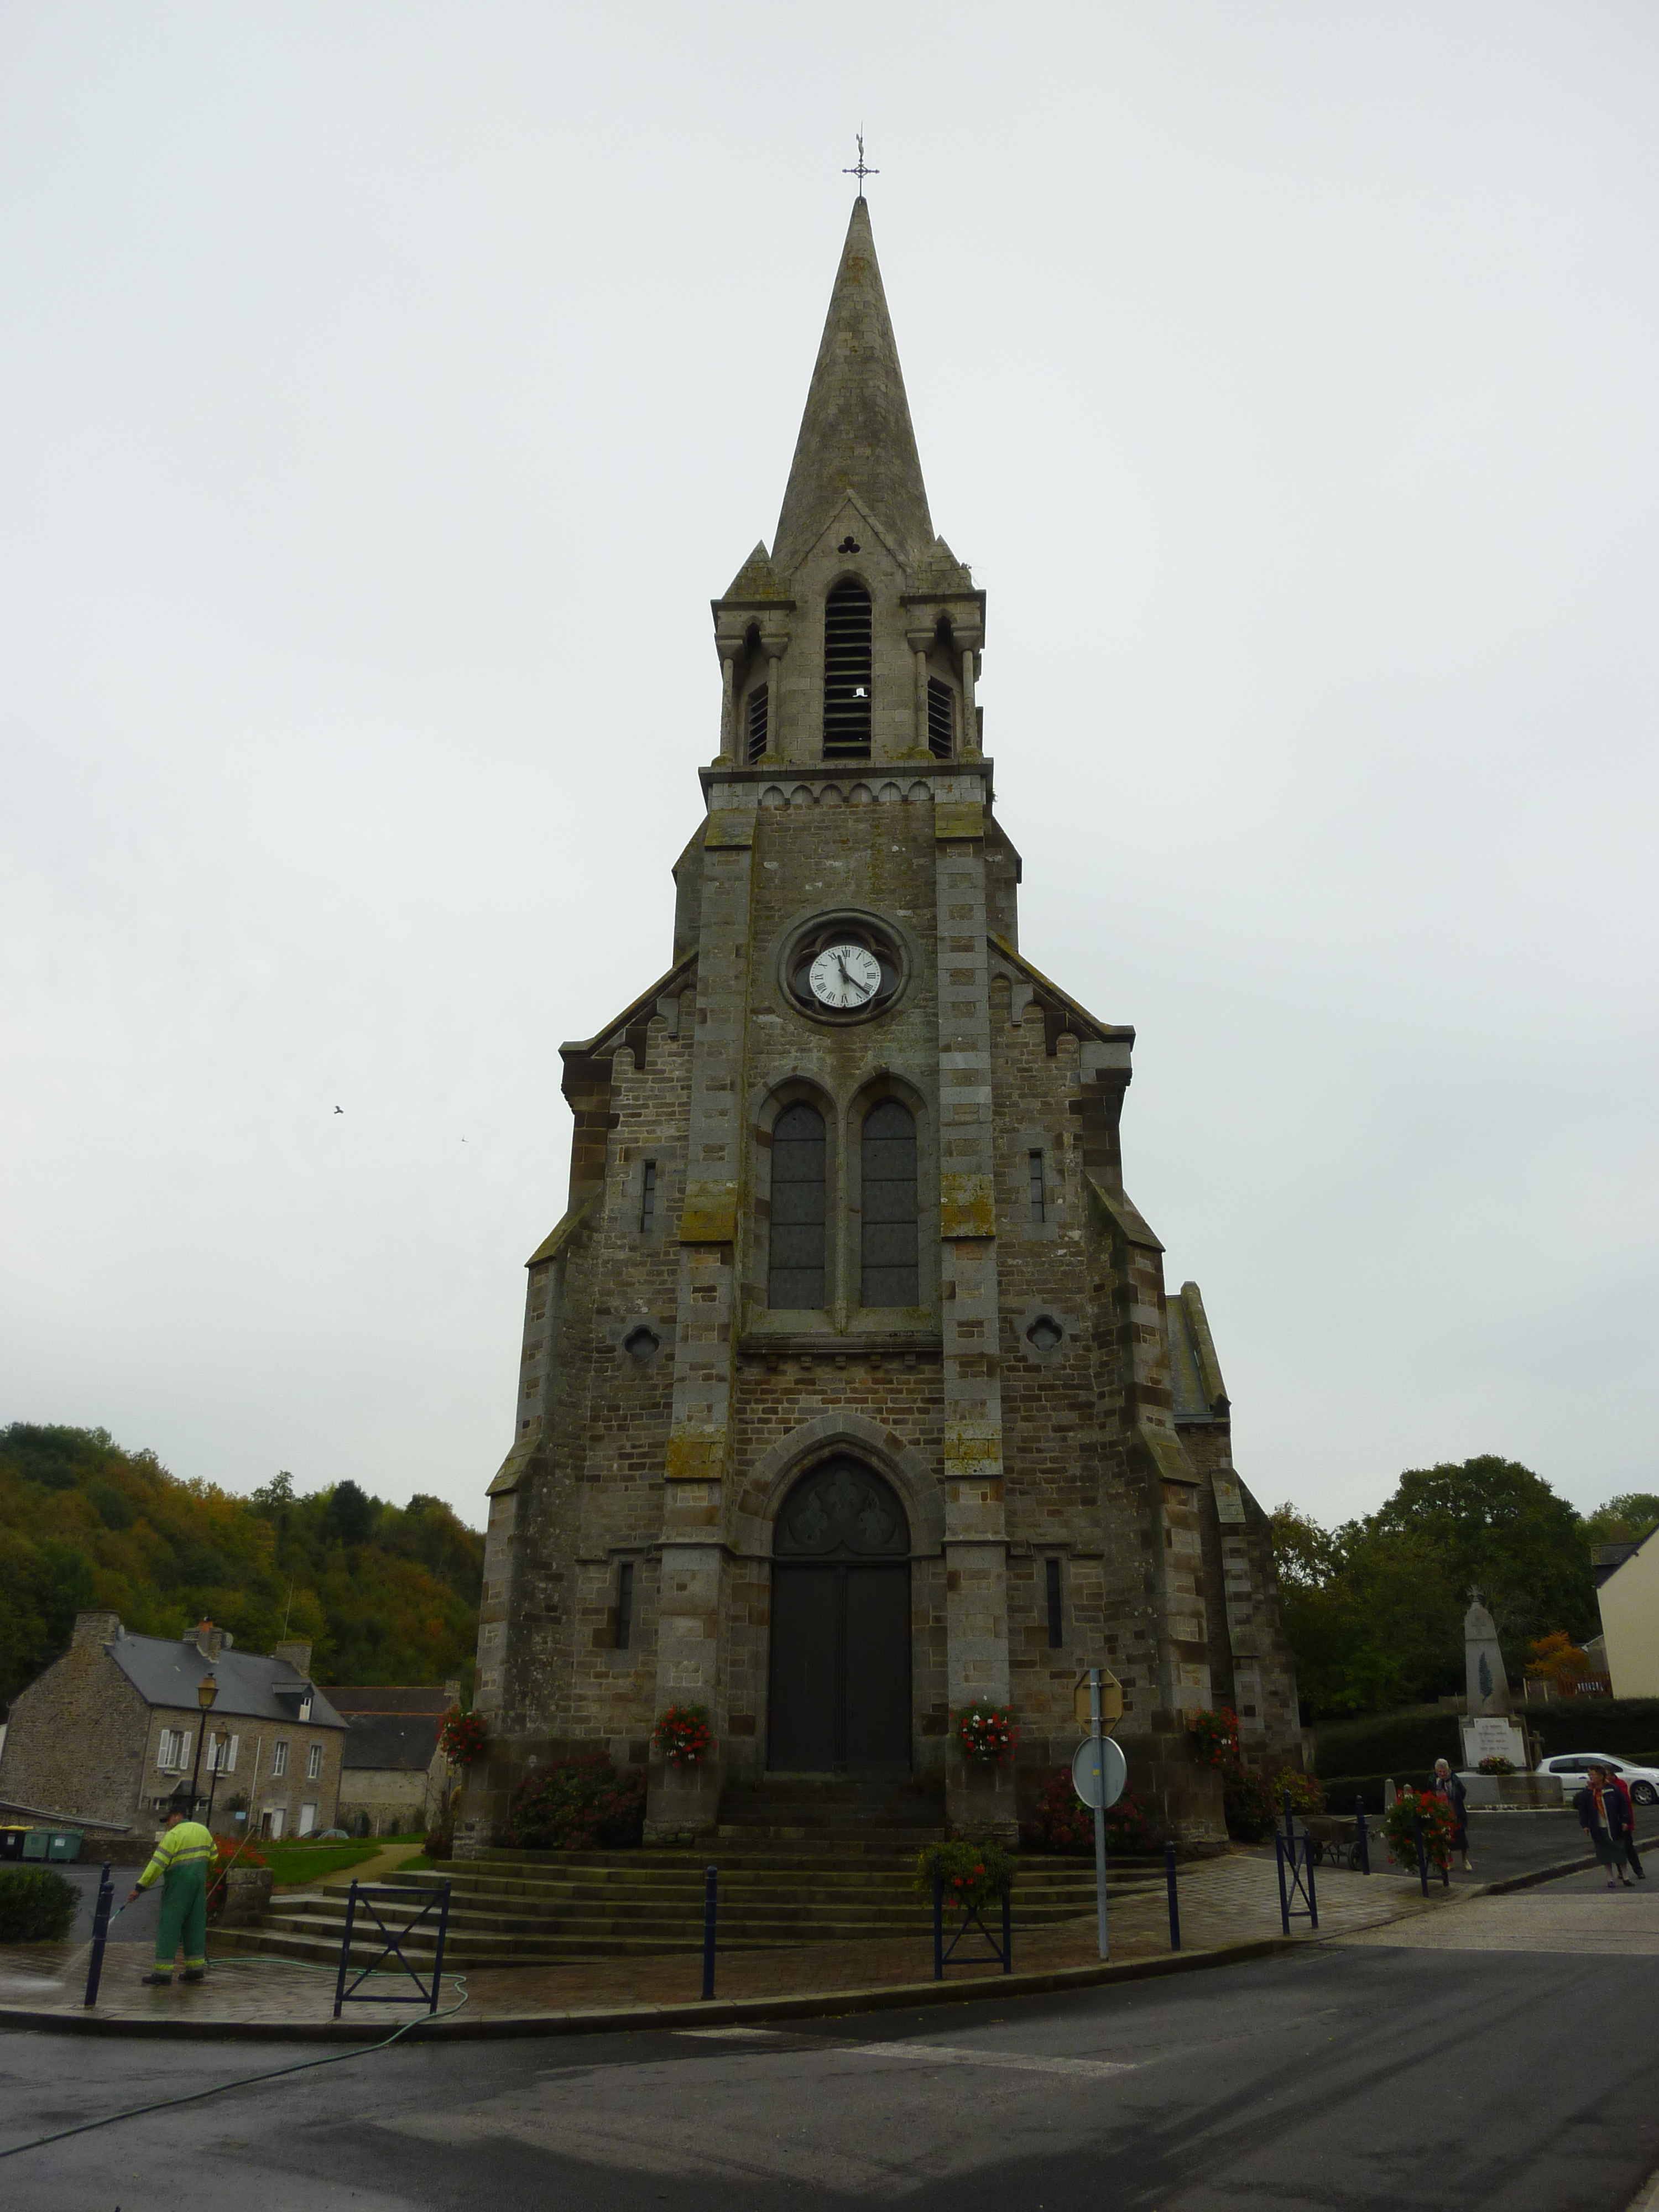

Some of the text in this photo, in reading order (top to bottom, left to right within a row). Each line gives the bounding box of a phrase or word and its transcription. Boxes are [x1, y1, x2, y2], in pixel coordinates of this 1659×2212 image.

[828, 952, 837, 962] XI
[842, 950, 850, 958] XII
[841, 995, 848, 1003] VI
